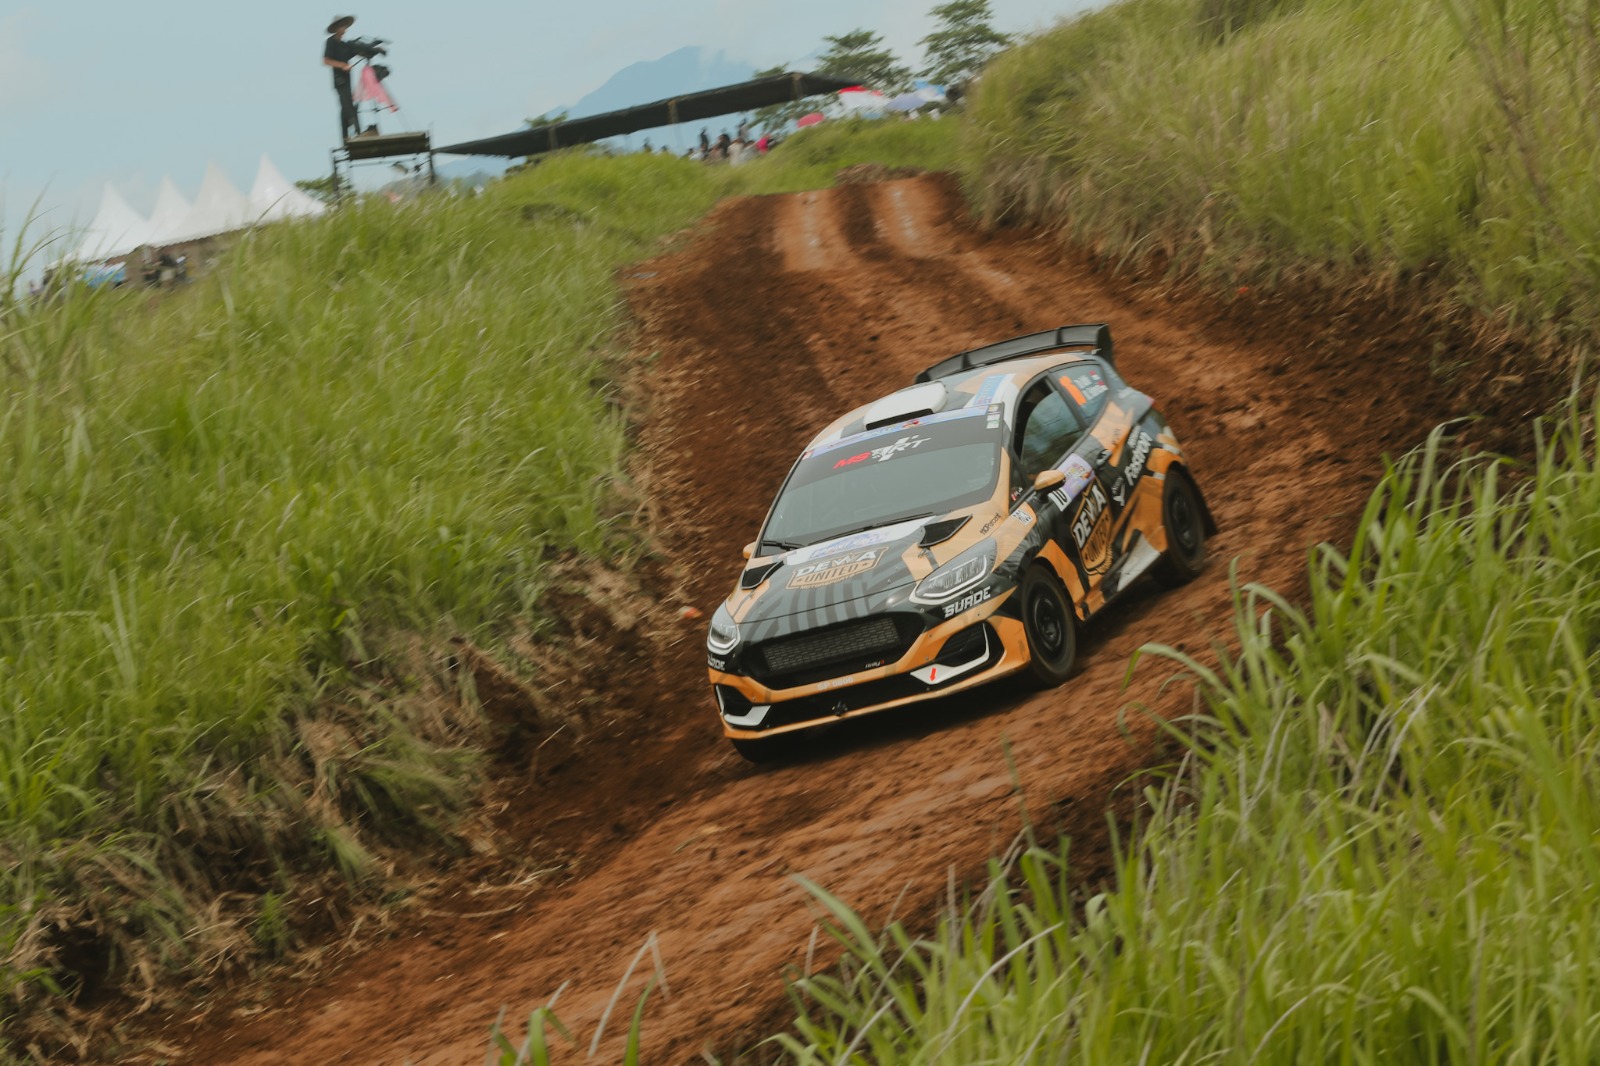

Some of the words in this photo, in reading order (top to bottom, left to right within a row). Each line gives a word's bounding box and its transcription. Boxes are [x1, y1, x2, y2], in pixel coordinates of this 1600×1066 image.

[1073, 484, 1107, 549] DEWA
[797, 550, 878, 577] DEWA
[806, 563, 860, 583] UNITED
